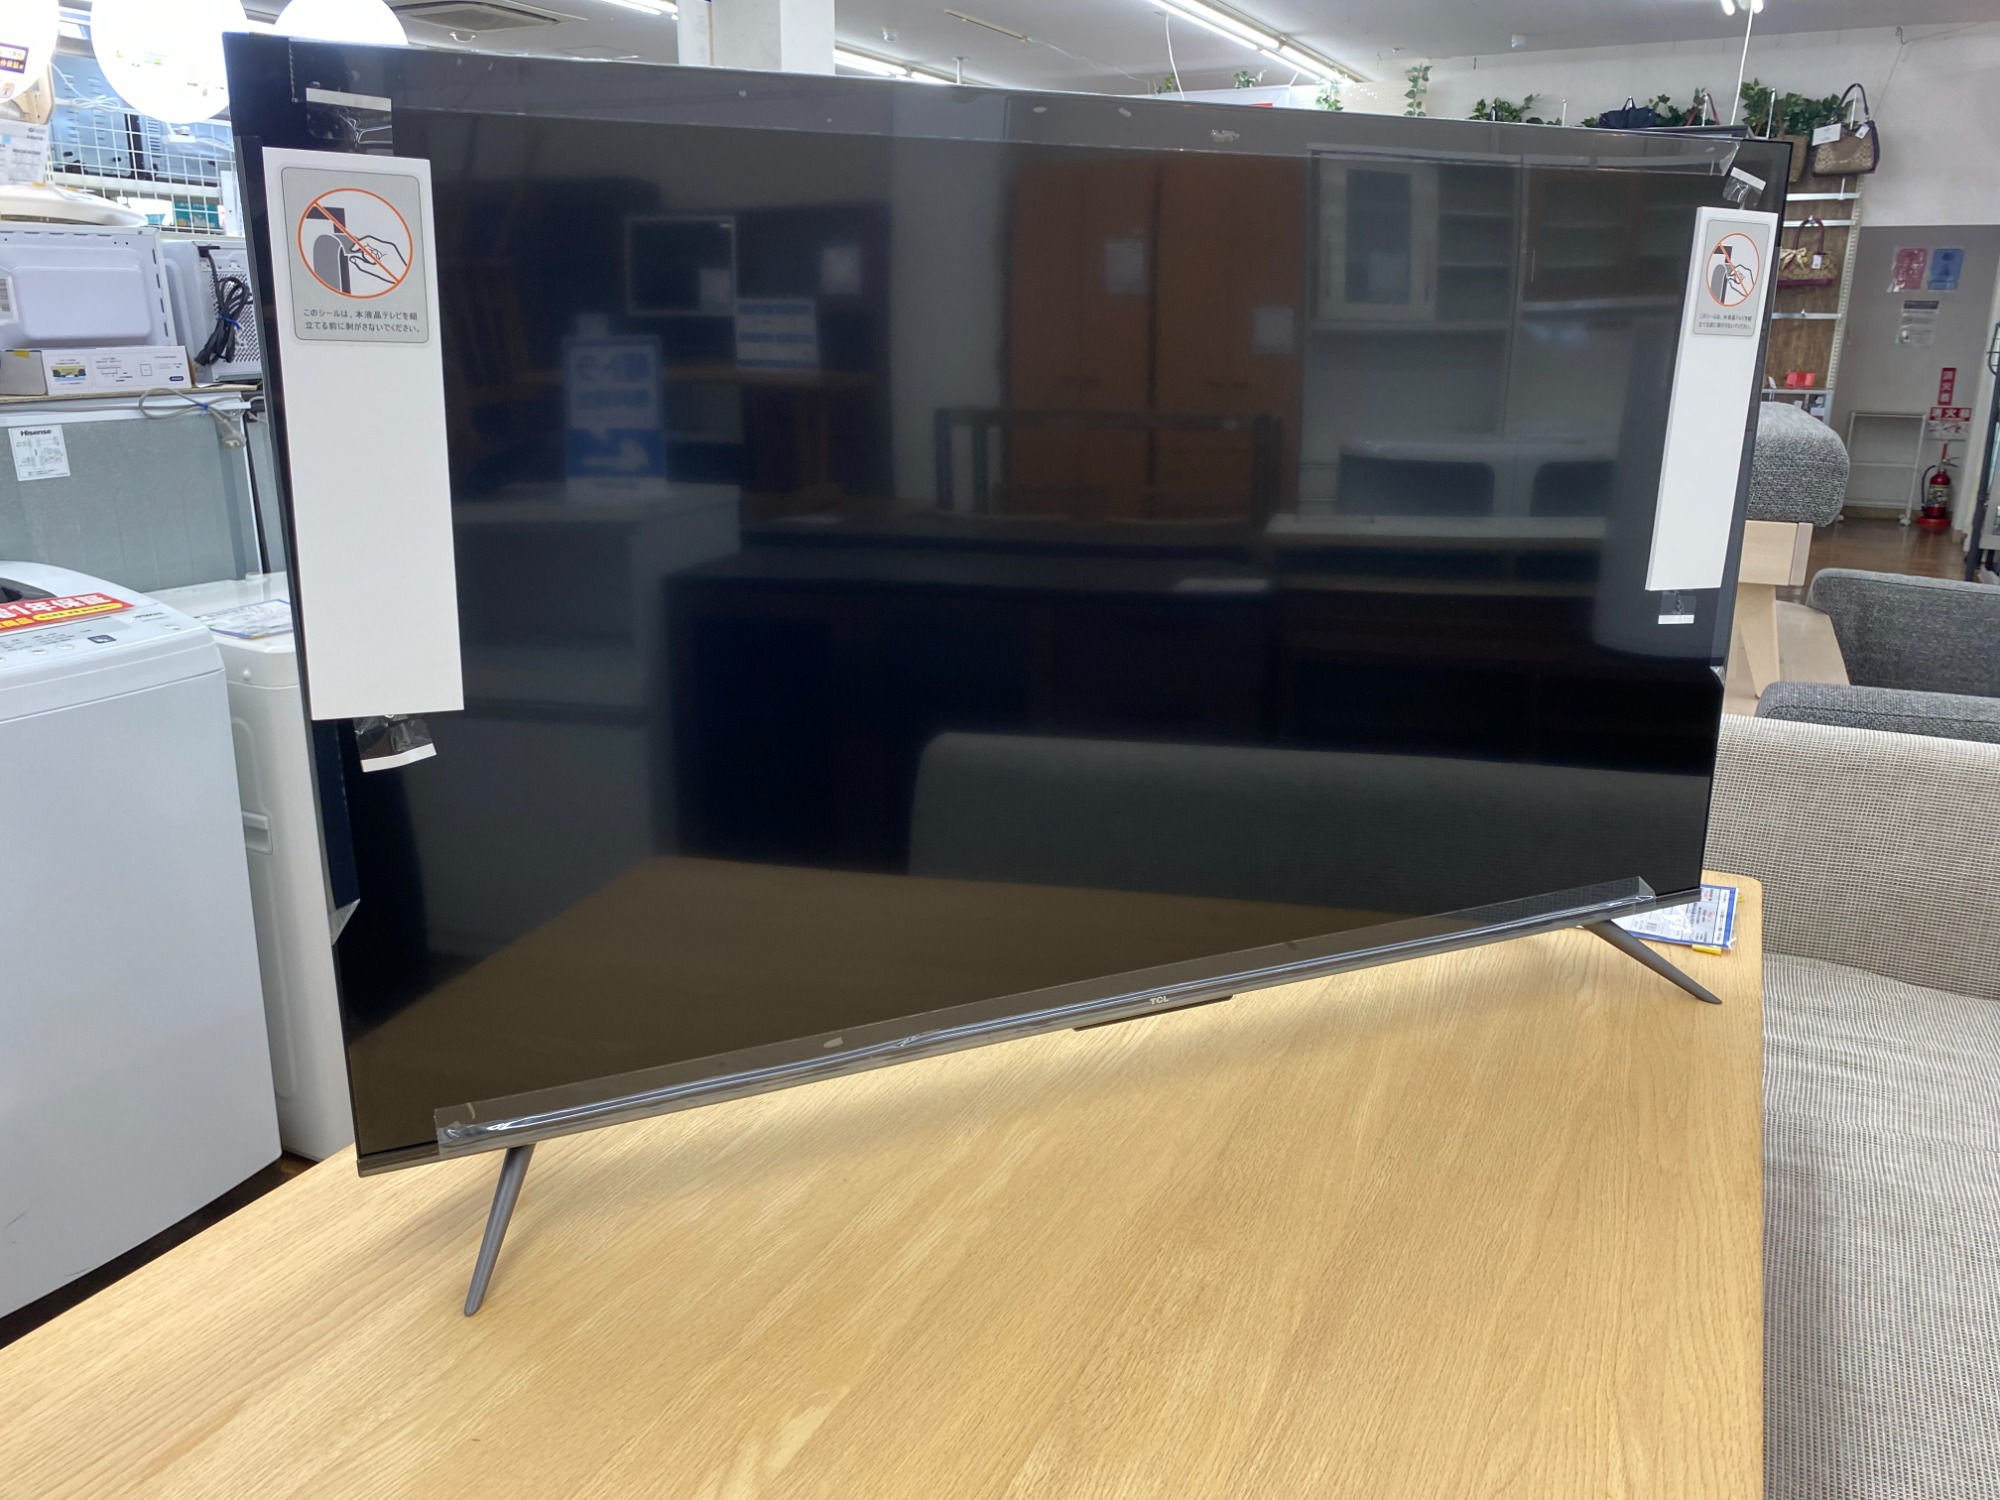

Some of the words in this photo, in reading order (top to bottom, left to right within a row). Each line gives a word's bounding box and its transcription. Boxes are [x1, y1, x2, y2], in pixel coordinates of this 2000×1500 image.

[303, 308, 418, 321] このシールは、本液晶テレビを組
[20, 429, 52, 437] Hisense
[1149, 995, 1169, 1006] TCL
